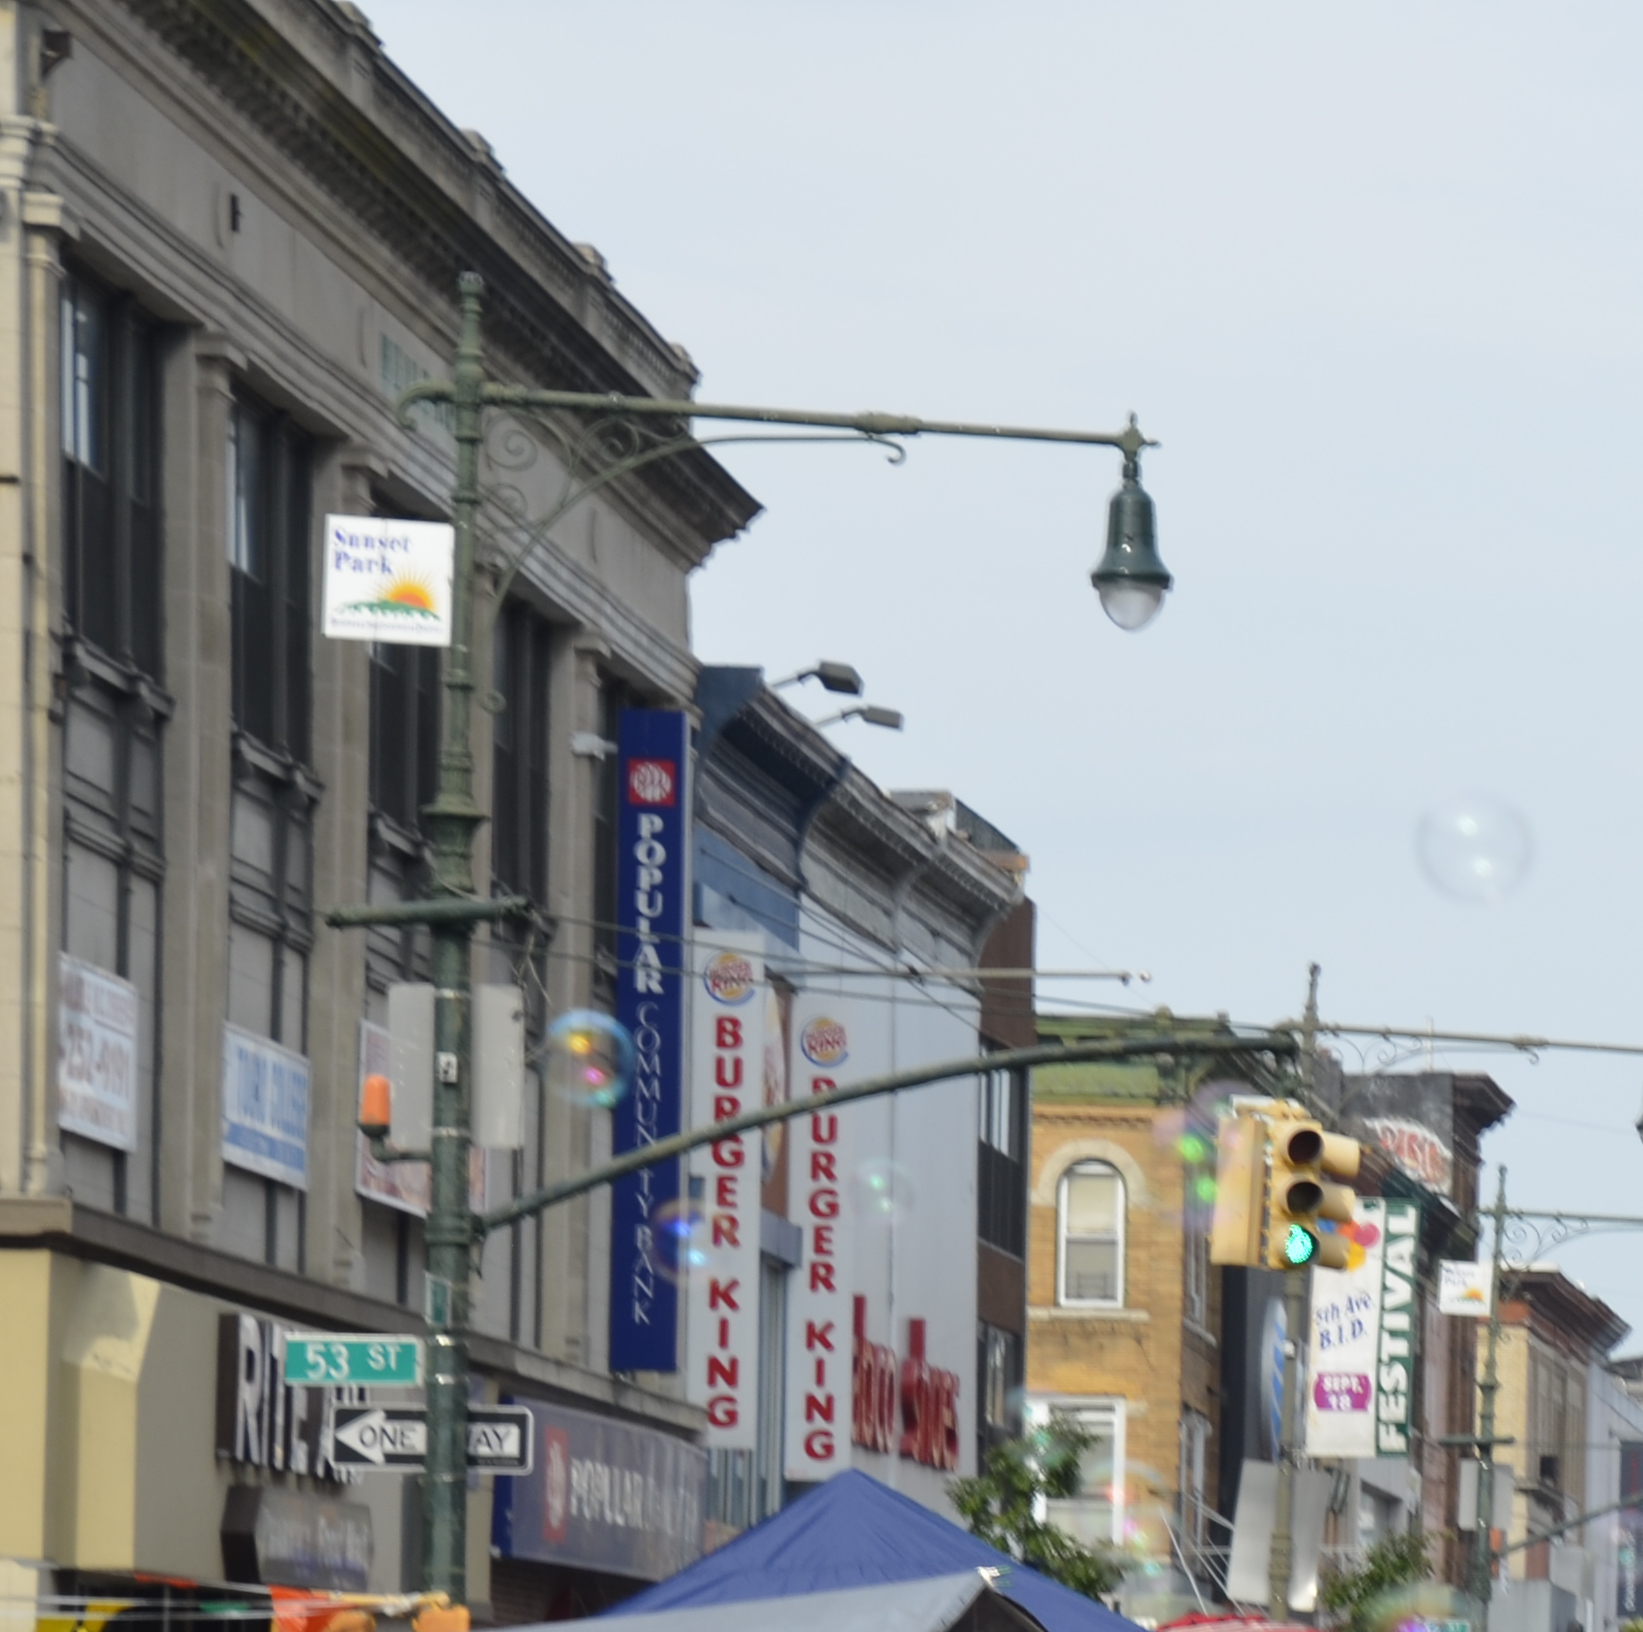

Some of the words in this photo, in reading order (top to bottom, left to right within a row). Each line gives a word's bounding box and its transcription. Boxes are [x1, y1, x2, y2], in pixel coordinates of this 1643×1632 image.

[334, 551, 393, 574] Park
[335, 529, 412, 552] Sunset
[633, 812, 666, 996] POPULAR
[631, 1001, 663, 1221] COMMUNITY
[711, 1016, 745, 1249] BURGER
[809, 1076, 839, 1294] BURGER
[632, 1224, 655, 1326] BANK
[305, 1343, 350, 1381] 53
[366, 1343, 402, 1371] ST
[707, 1278, 740, 1428] KING
[1319, 1318, 1367, 1350] B.I.D.
[1377, 1203, 1417, 1451] FESTIVAL
[804, 1320, 835, 1462] KING
[1322, 1374, 1365, 1394] SEPT.
[1328, 1394, 1352, 1411] 18
[358, 1424, 418, 1451] ONE
